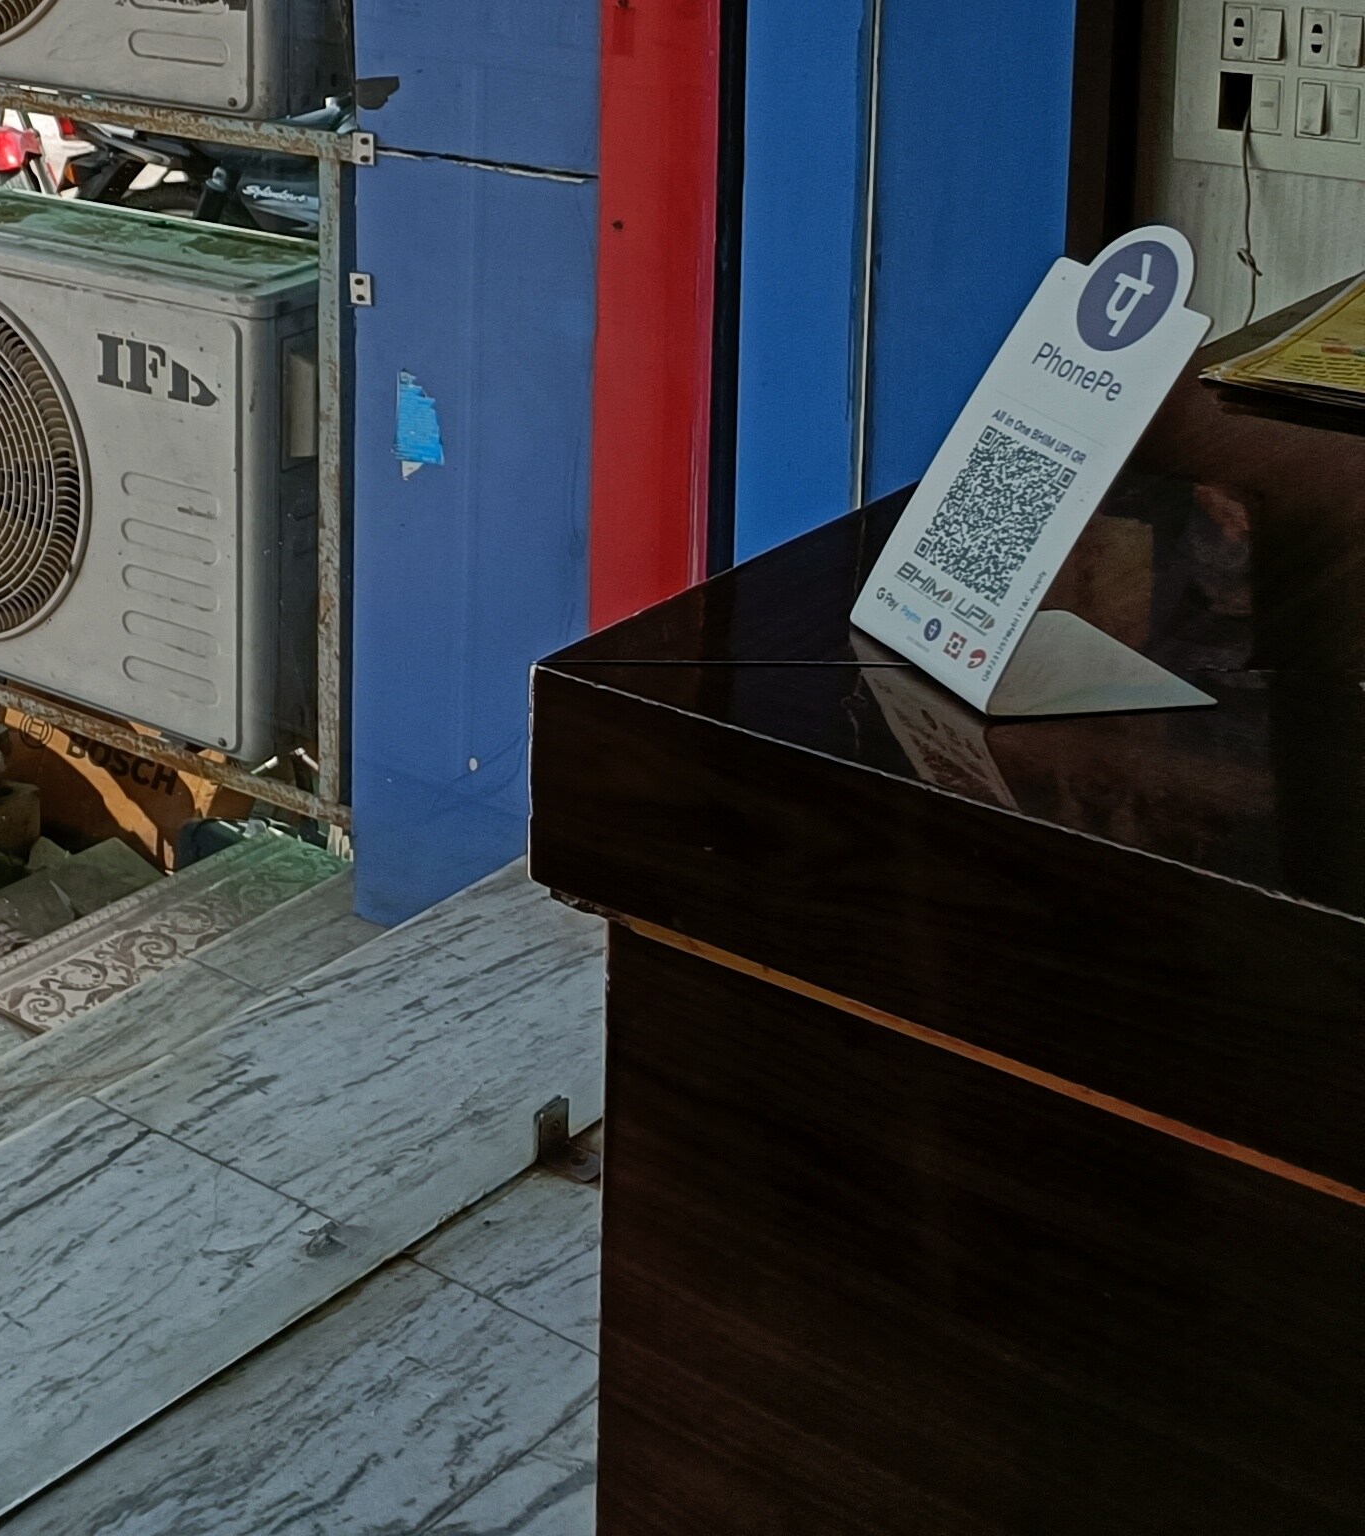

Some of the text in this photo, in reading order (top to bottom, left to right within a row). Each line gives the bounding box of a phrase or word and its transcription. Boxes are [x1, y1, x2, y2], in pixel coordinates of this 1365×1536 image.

[1106, 252, 1154, 338] पे
[1032, 342, 1122, 401] PhonePe
[991, 409, 1007, 422] All
[1014, 420, 1031, 436] One
[1030, 429, 1056, 449] BHIM
[1054, 441, 1072, 457] UPI
[1071, 450, 1087, 465] QR
[897, 561, 994, 629] BHIM UPI
[67, 735, 178, 796] BOSCH
